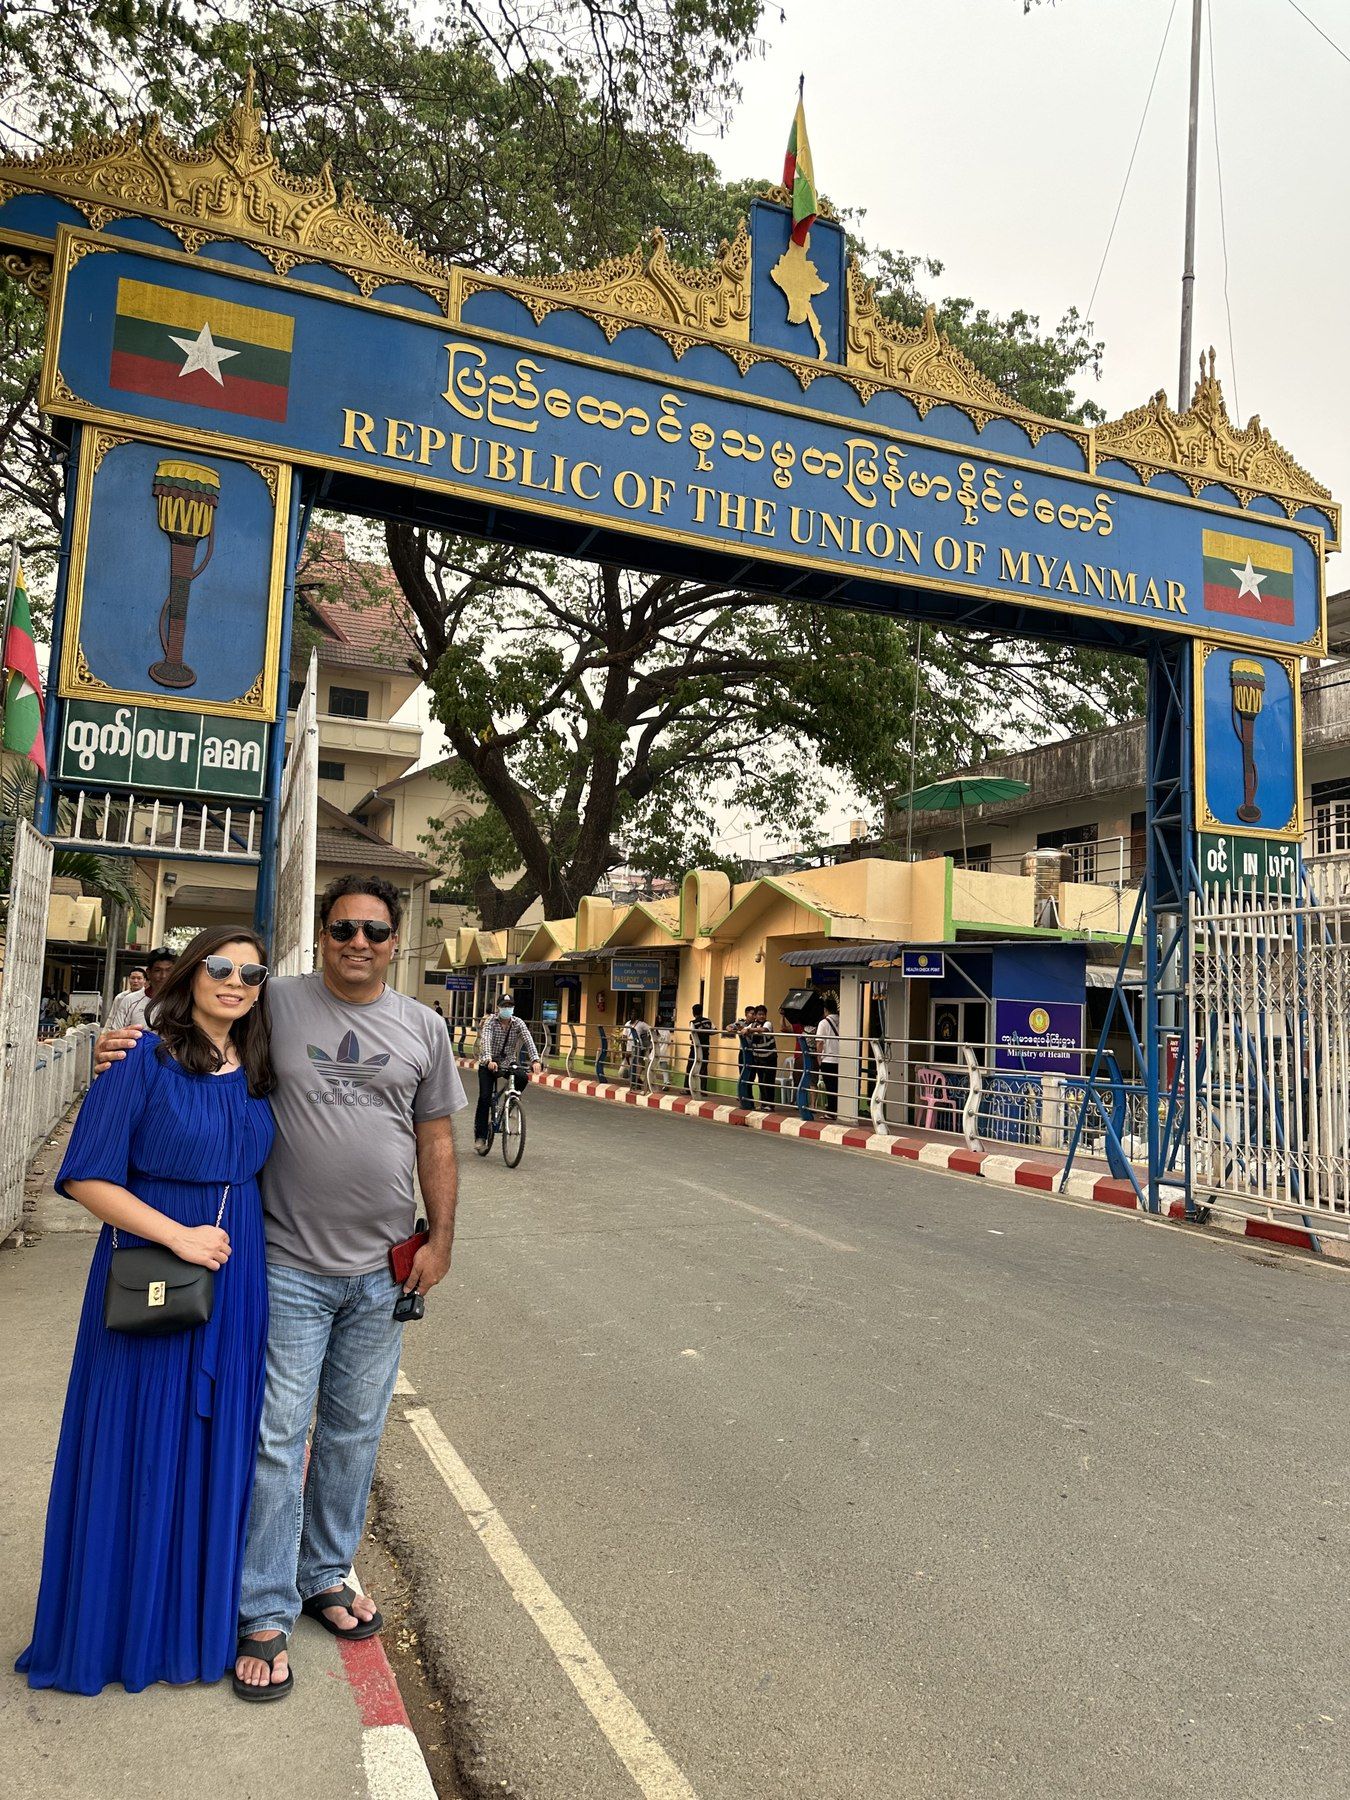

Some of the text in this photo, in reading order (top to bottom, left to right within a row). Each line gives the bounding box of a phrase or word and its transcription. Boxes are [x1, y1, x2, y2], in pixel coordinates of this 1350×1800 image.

[340, 408, 1189, 615] REPUBLIC OF THE UNION OF MYANMAR
[136, 728, 196, 763] OUT
[203, 736, 261, 772] ออก
[1243, 852, 1258, 875] IN
[1268, 846, 1295, 878] เข้า
[643, 976, 657, 984] ONLY
[1048, 1051, 1071, 1059] Health
[306, 1087, 384, 1108] adidas
